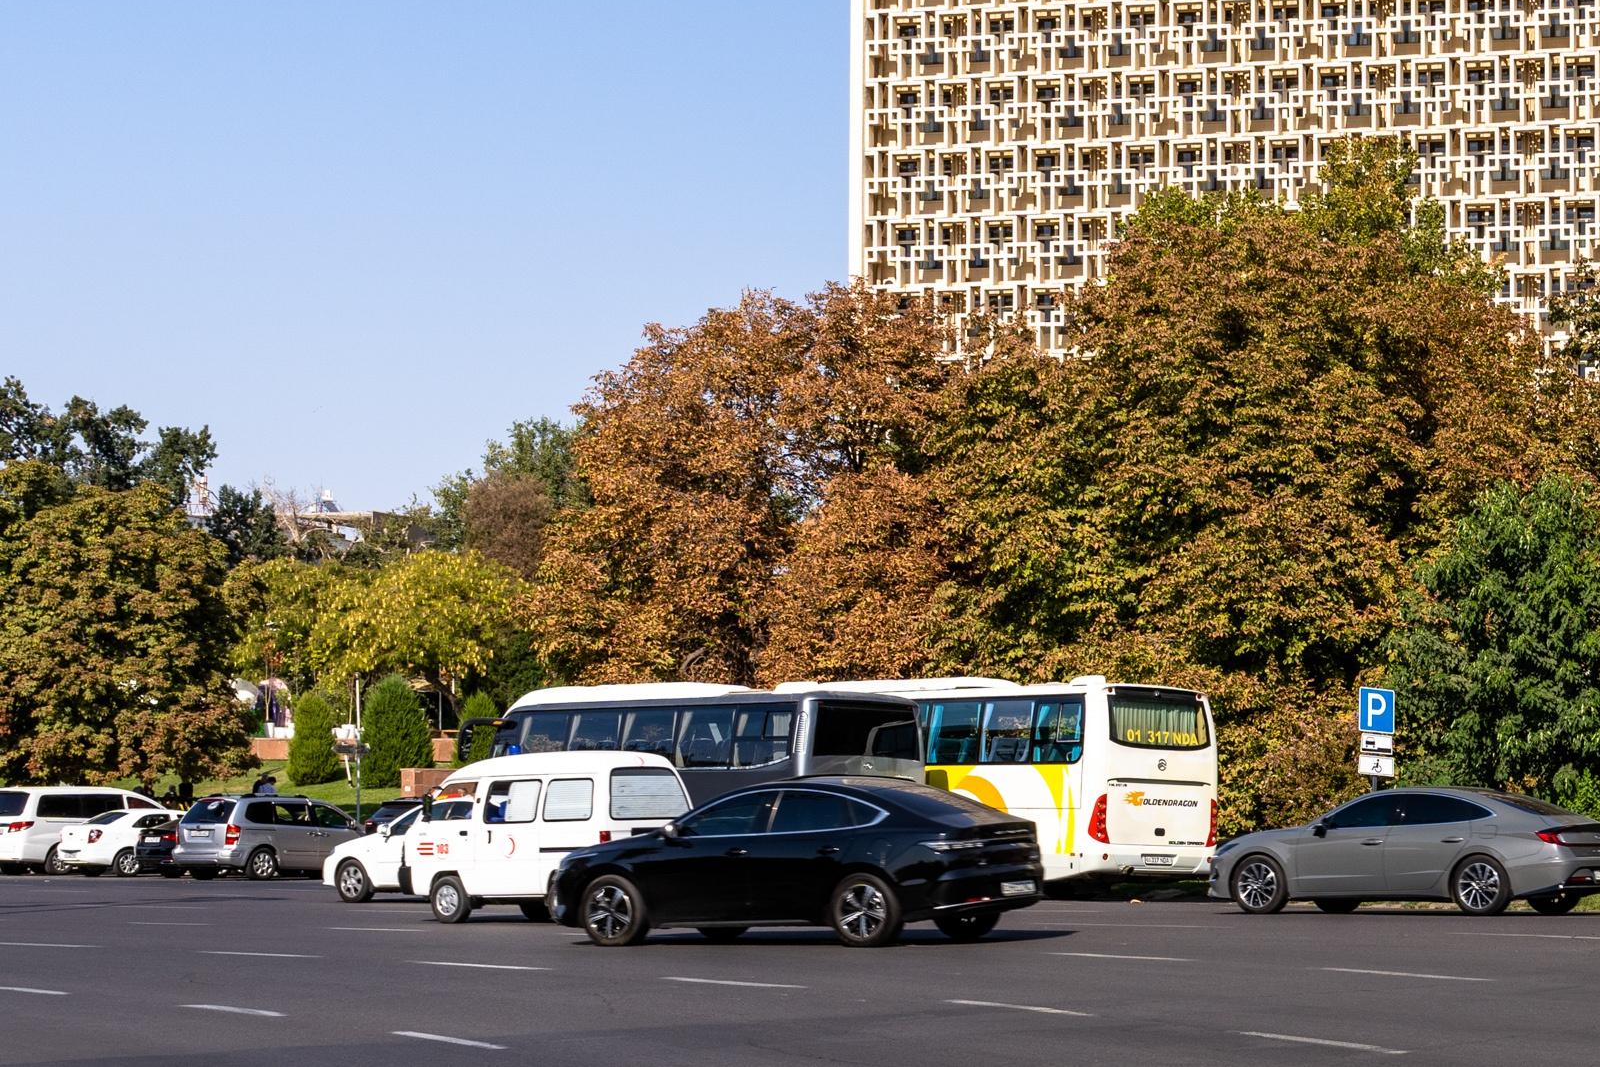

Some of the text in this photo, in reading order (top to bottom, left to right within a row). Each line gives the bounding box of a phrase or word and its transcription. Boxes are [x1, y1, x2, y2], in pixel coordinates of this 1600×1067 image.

[1367, 692, 1387, 727] P
[1126, 728, 1199, 746] 01 317 NDA
